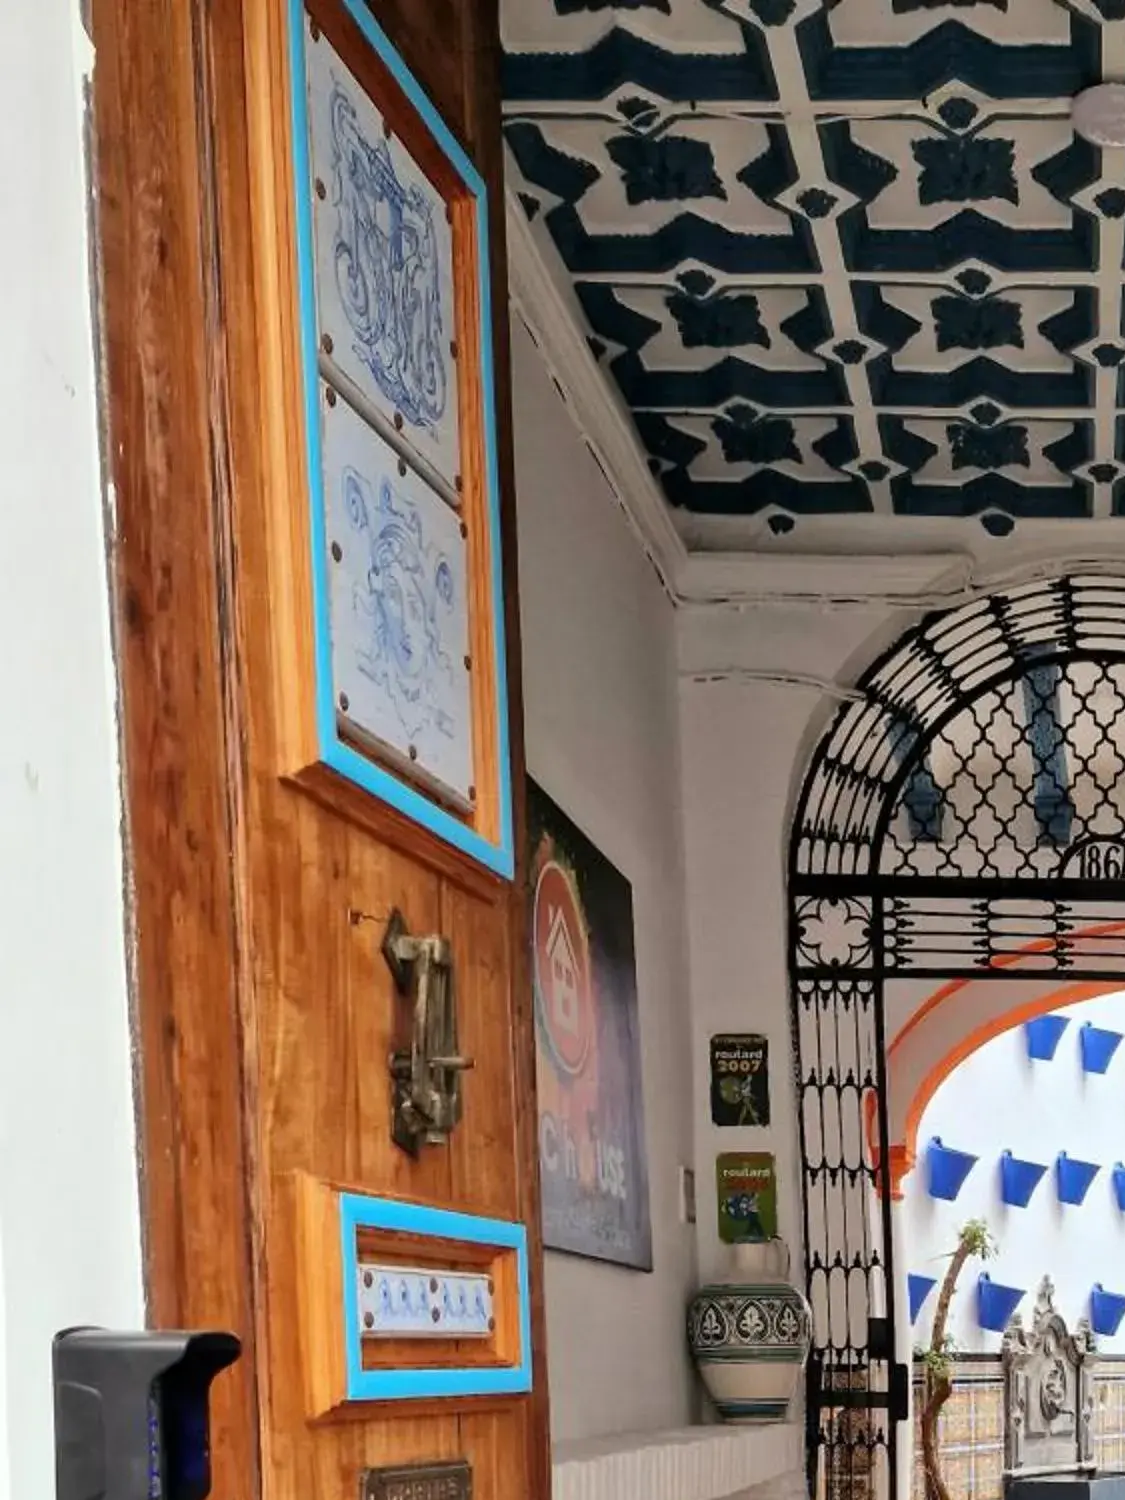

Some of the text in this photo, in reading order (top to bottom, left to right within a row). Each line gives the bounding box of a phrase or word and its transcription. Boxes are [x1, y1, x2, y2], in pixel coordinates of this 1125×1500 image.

[715, 1049, 763, 1059] routard
[717, 1060, 761, 1073] 2007
[723, 1168, 771, 1177] routard
